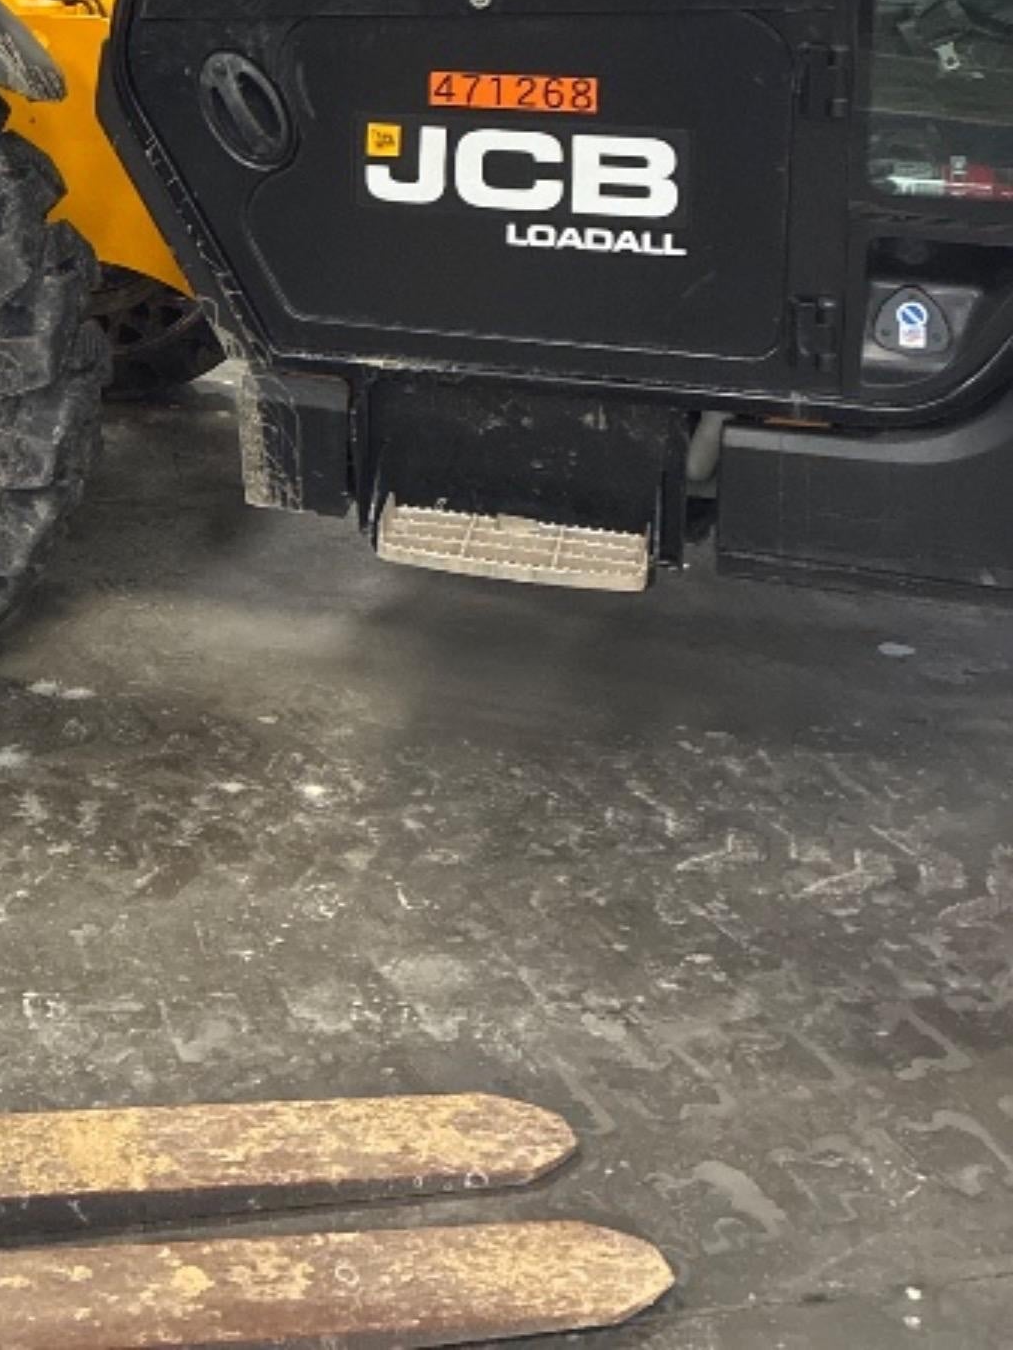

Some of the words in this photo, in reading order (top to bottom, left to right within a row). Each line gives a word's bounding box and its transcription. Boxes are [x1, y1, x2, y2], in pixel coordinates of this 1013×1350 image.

[433, 73, 593, 109] 471268
[365, 125, 679, 218] JCB
[505, 222, 688, 257] LOADALL
